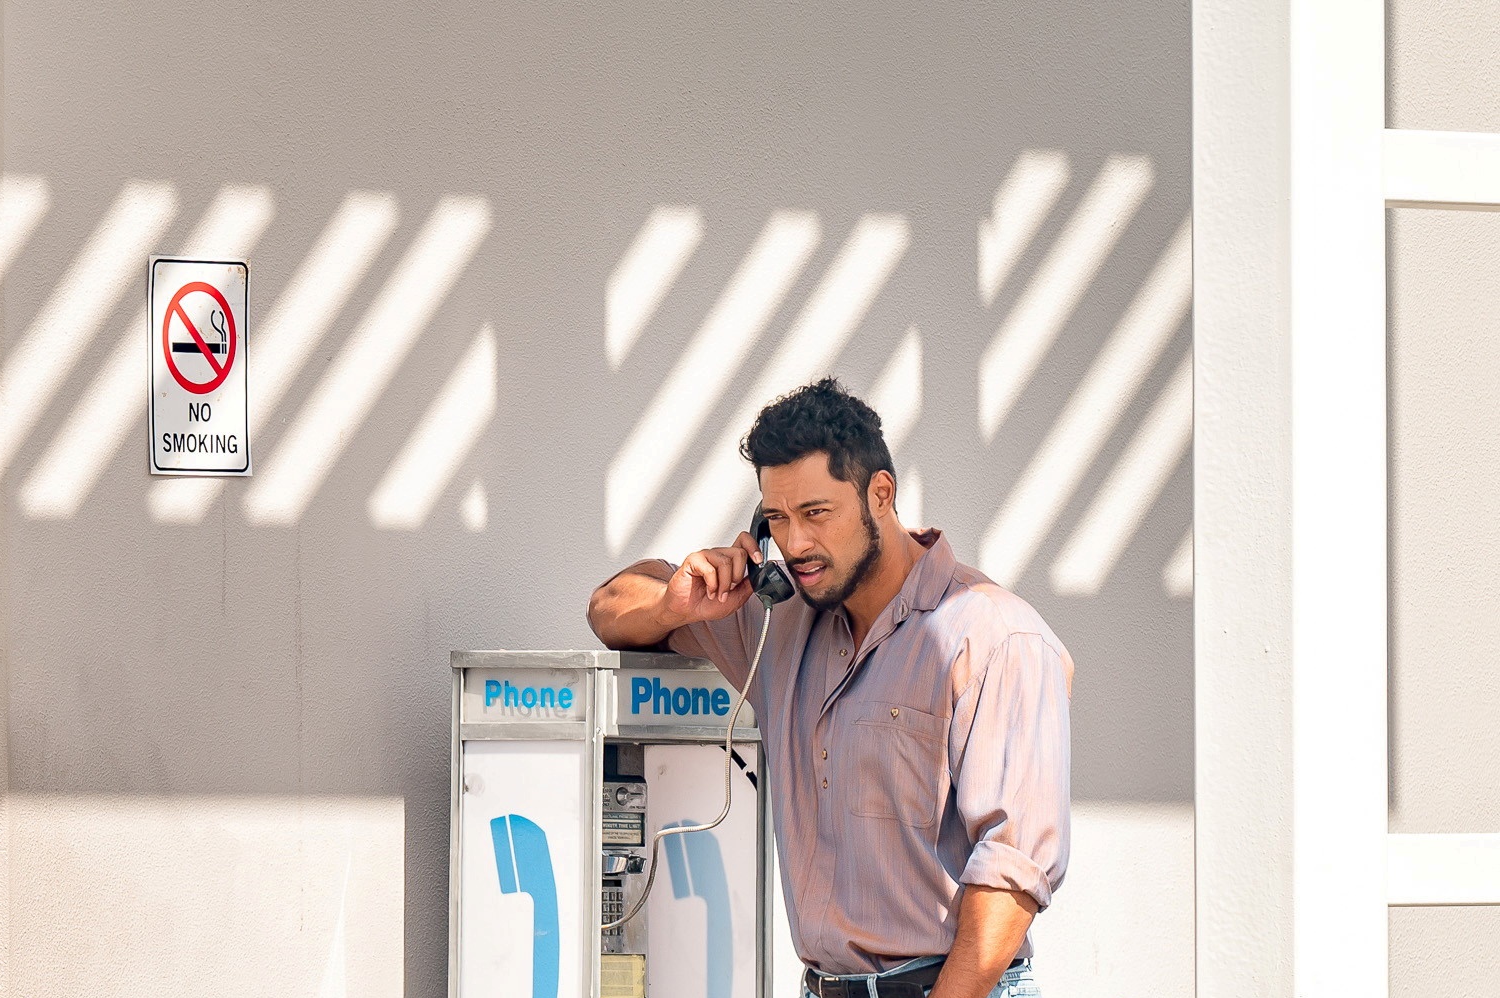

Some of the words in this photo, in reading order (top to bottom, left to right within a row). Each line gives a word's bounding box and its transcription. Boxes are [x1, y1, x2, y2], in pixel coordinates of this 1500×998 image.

[188, 402, 212, 422] NO
[162, 432, 238, 454] SMOKING
[485, 679, 573, 709] Phone
[631, 676, 731, 716] Phone
